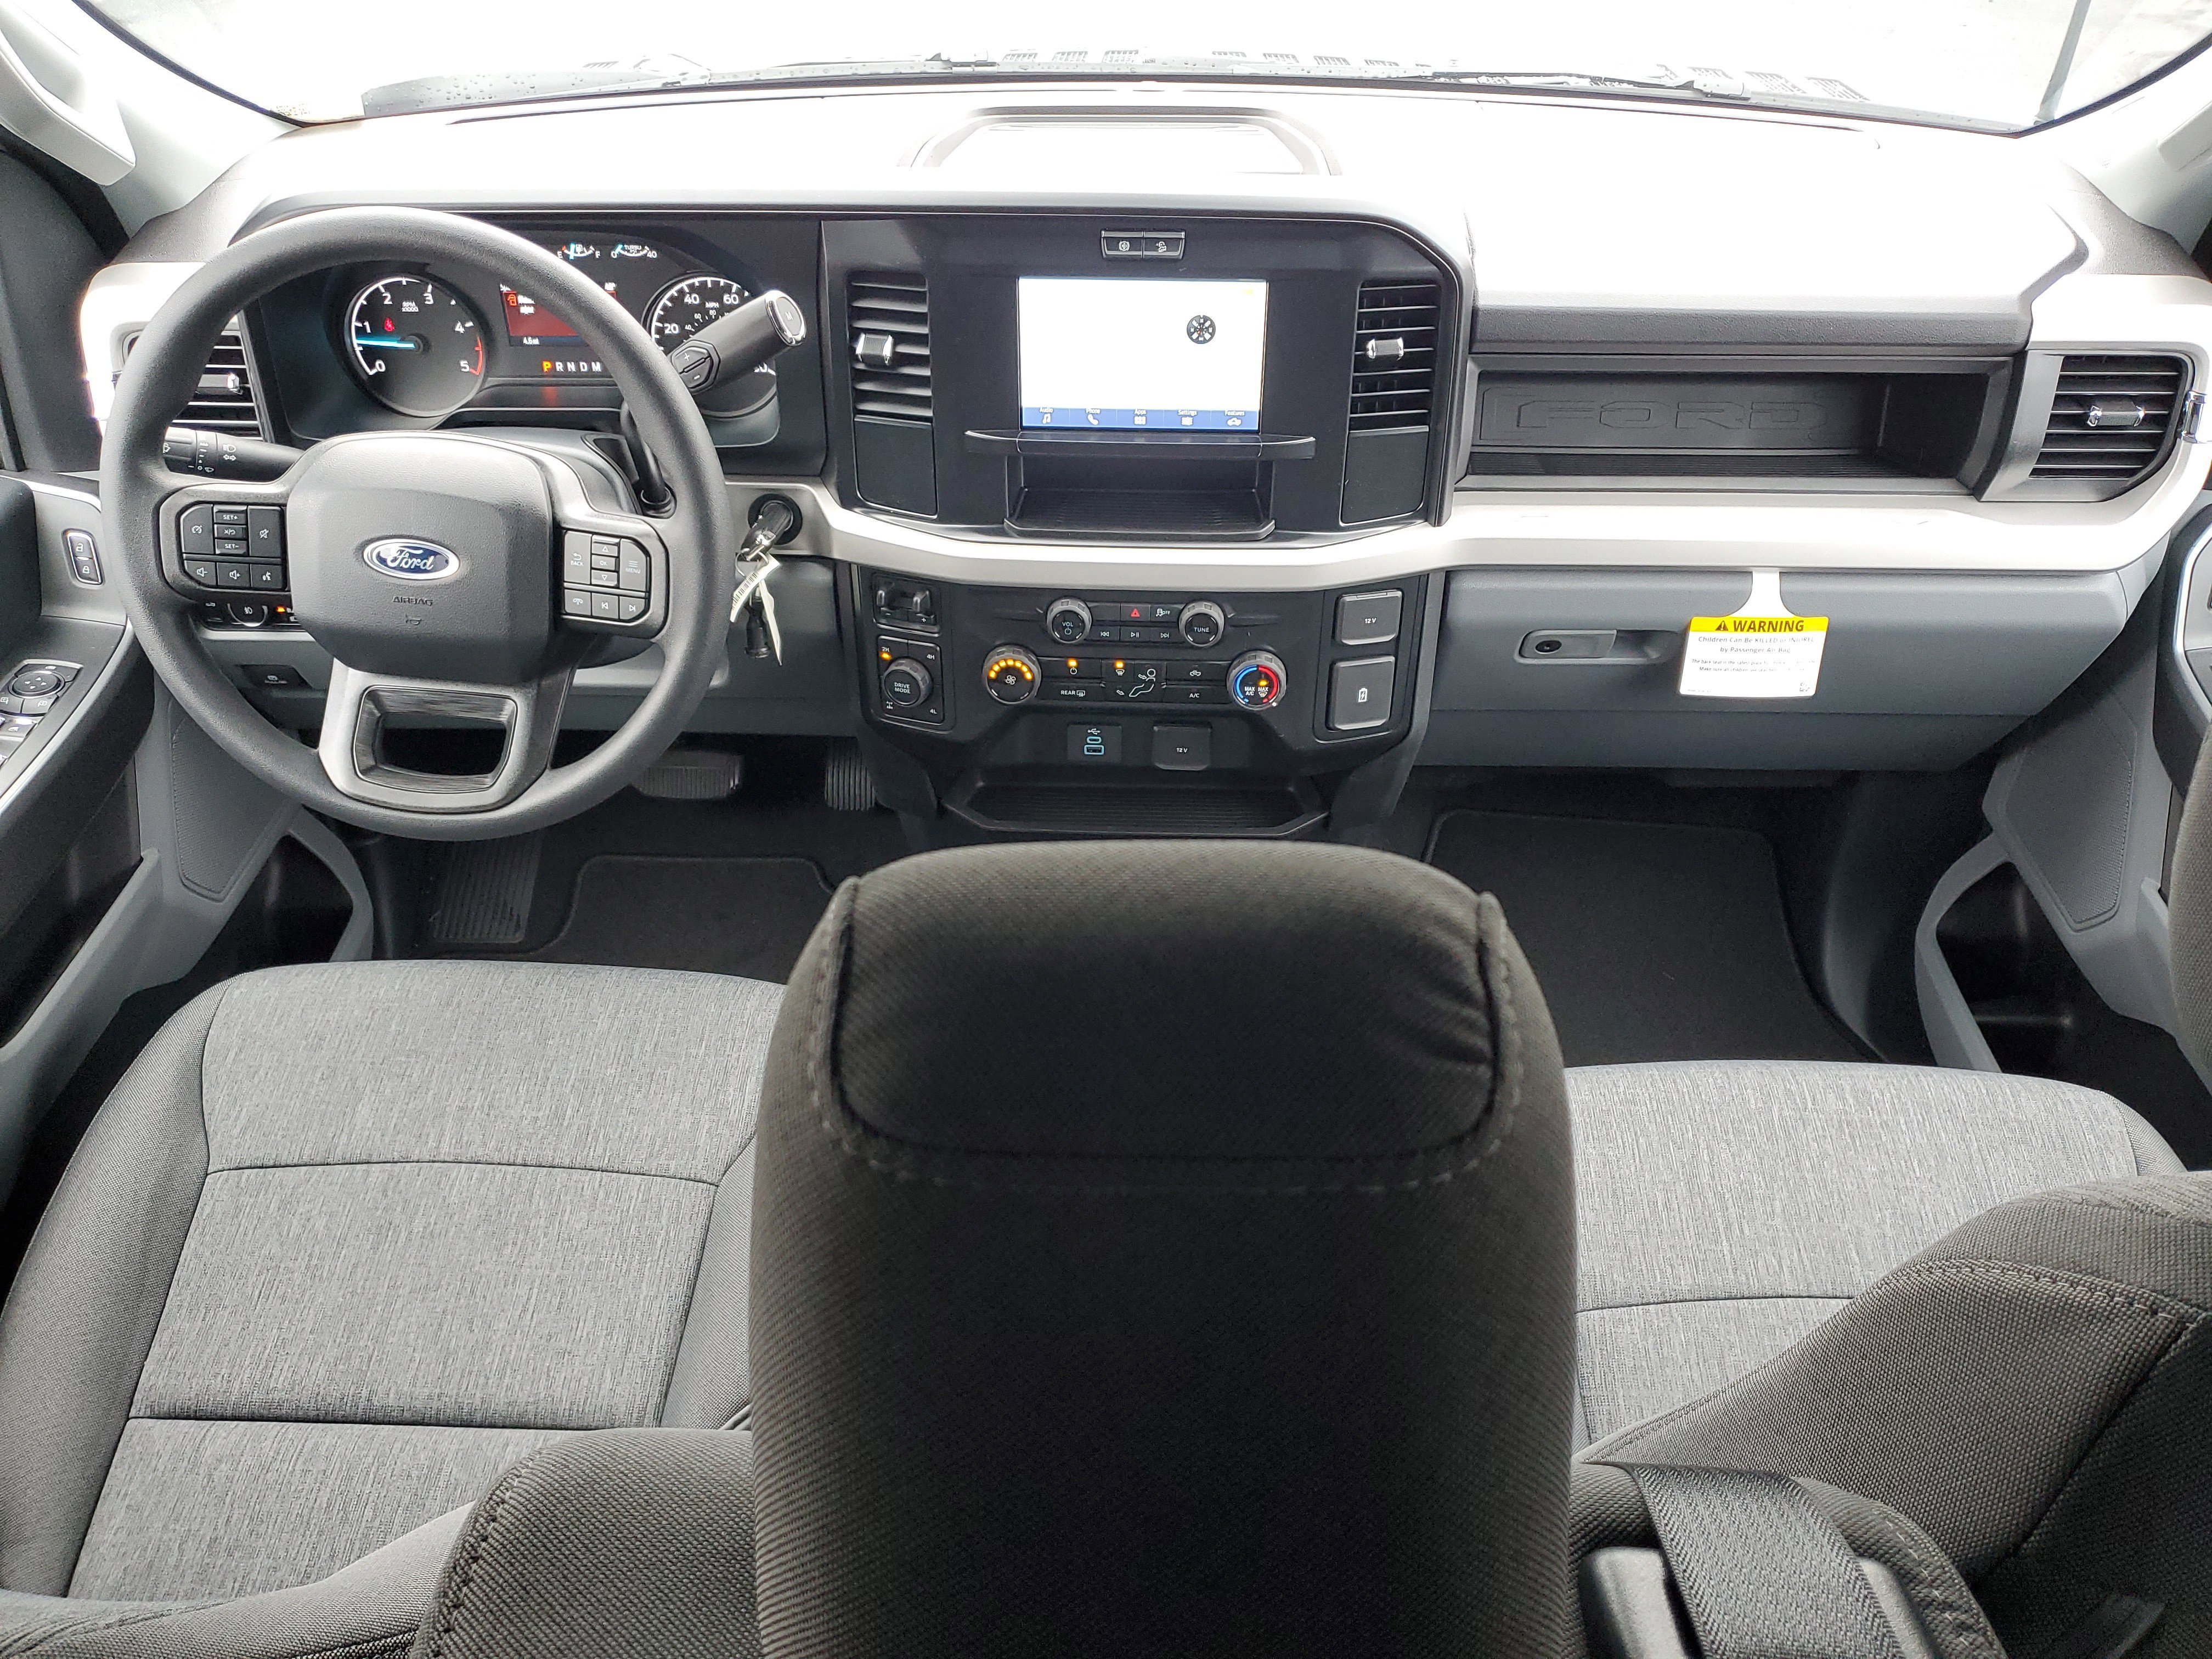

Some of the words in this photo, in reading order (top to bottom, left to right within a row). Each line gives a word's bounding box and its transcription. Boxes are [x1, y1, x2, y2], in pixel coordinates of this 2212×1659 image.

[647, 251, 657, 259] 40
[382, 292, 393, 304] 2
[423, 292, 433, 304] 3
[684, 294, 699, 304] 40
[723, 294, 739, 304] 60
[364, 321, 371, 333] 1
[455, 321, 465, 334] 4
[664, 323, 679, 334] 20
[375, 359, 386, 372] 0
[460, 360, 470, 372] 5
[542, 360, 552, 372] P
[555, 361, 564, 372] R
[567, 361, 576, 372] N
[579, 361, 588, 372] D
[591, 361, 601, 372] M
[1516, 400, 1829, 430] FORD
[380, 546, 436, 571] Ford
[393, 596, 433, 606] AIRBAG
[1733, 619, 1804, 633] WARNING
